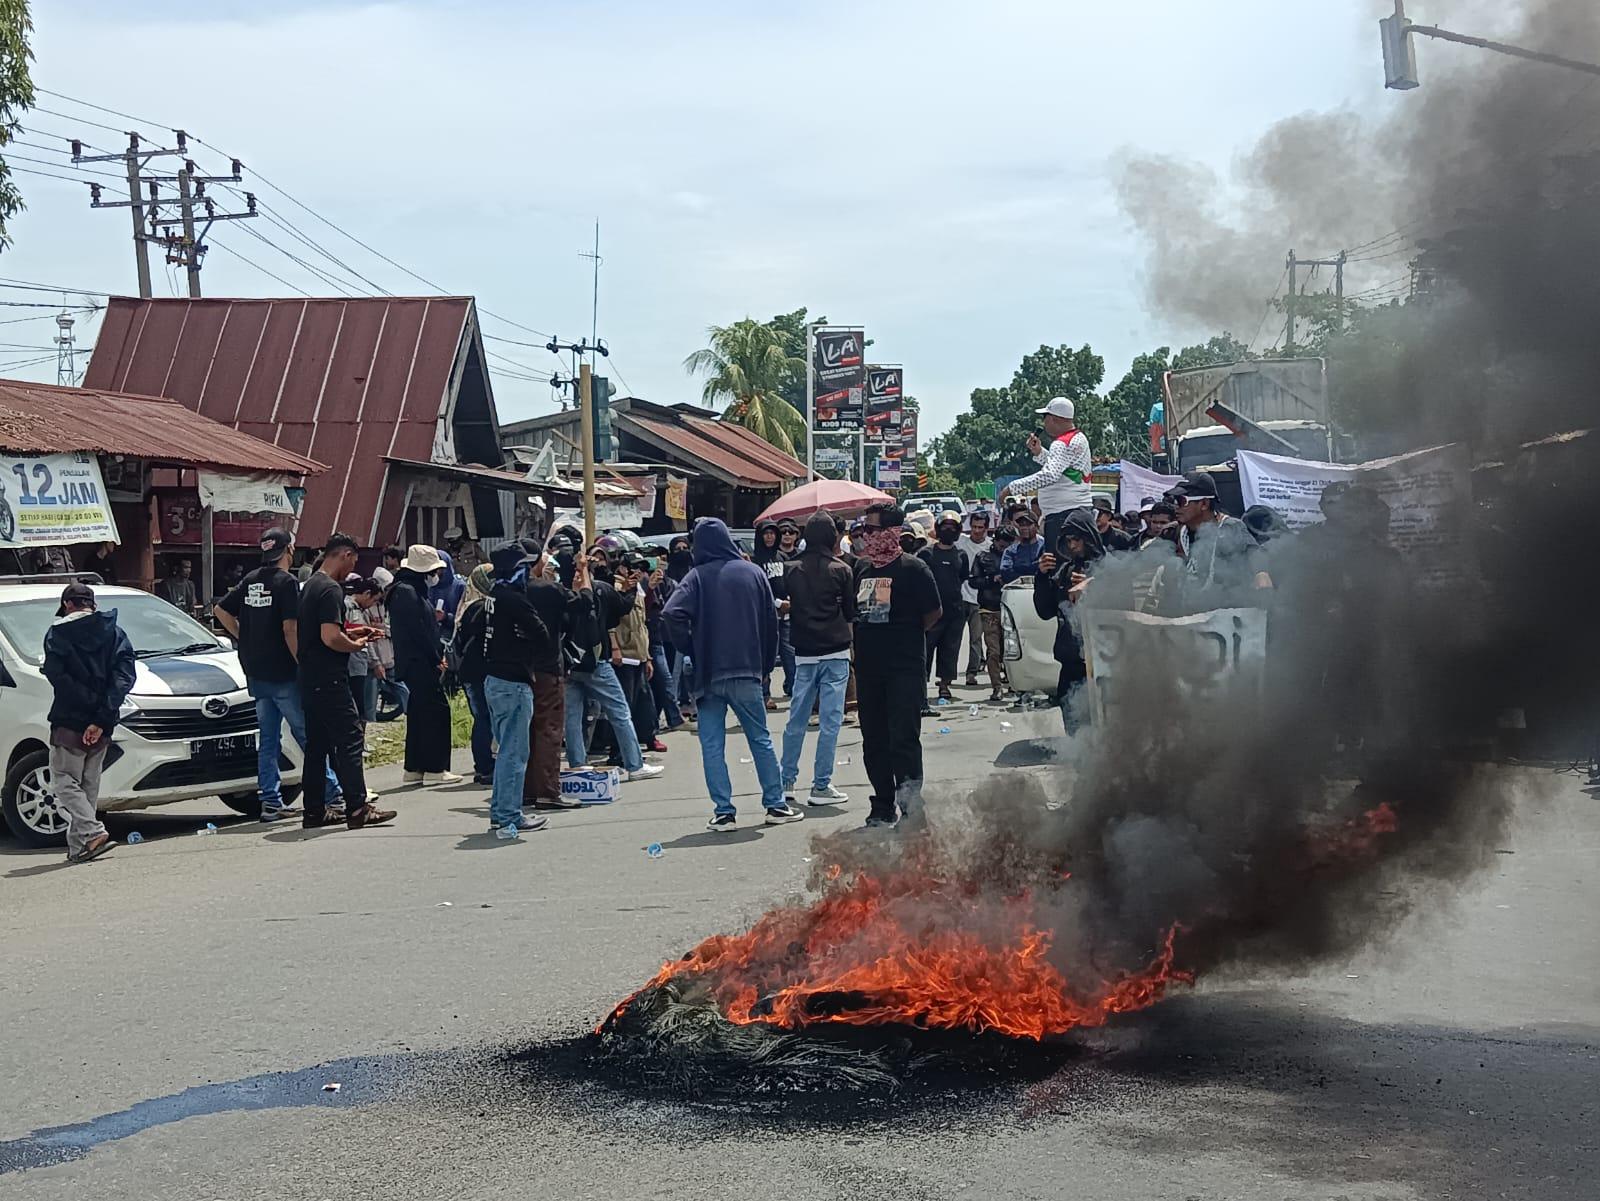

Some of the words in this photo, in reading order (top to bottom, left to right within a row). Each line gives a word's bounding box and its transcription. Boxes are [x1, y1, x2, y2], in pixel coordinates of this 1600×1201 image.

[12, 463, 57, 505] 12
[58, 482, 100, 505] JAM
[920, 503, 944, 513] 03
